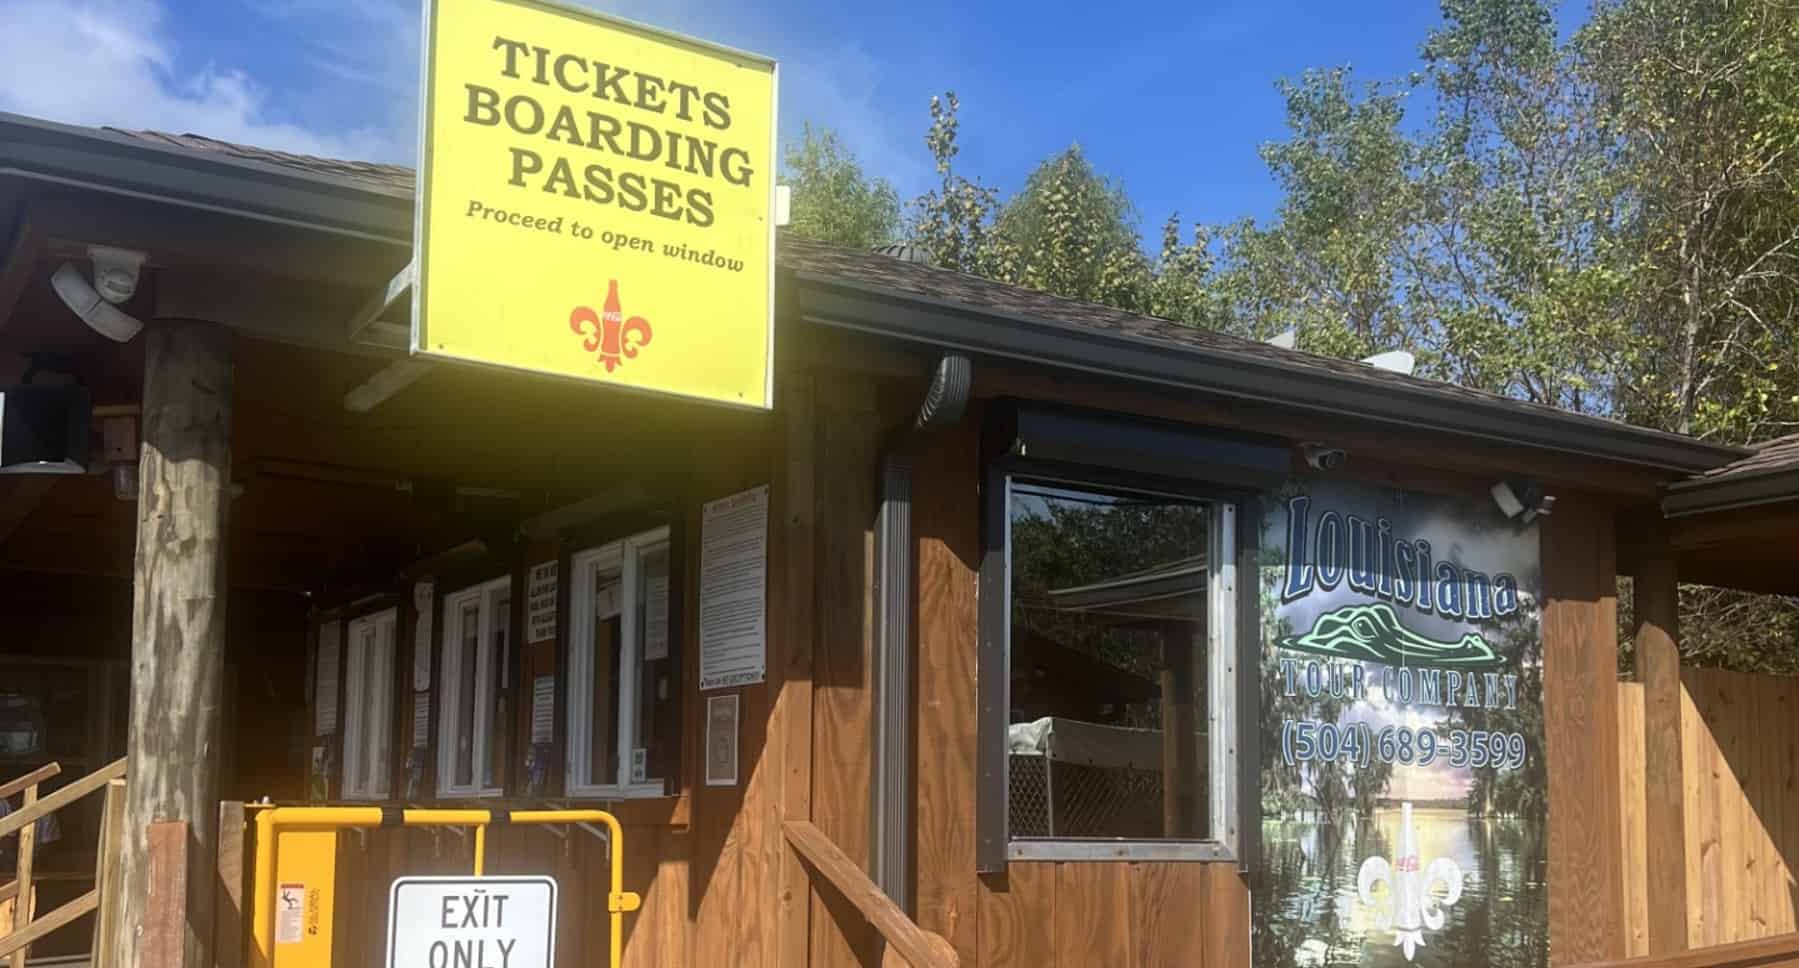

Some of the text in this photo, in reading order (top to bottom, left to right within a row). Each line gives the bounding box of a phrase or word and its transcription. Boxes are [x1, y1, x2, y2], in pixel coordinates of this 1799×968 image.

[492, 36, 732, 131] TICKETS
[463, 83, 754, 188] BOARDING
[508, 147, 715, 229] PASSES
[466, 200, 744, 273] Proceed to open window
[1280, 496, 1520, 622] Louisiana
[1280, 658, 1519, 710] TOUR COMPANY
[1281, 719, 1526, 770] (504) 689-3599
[441, 895, 509, 928] EXIT
[429, 938, 516, 968] ONLY
